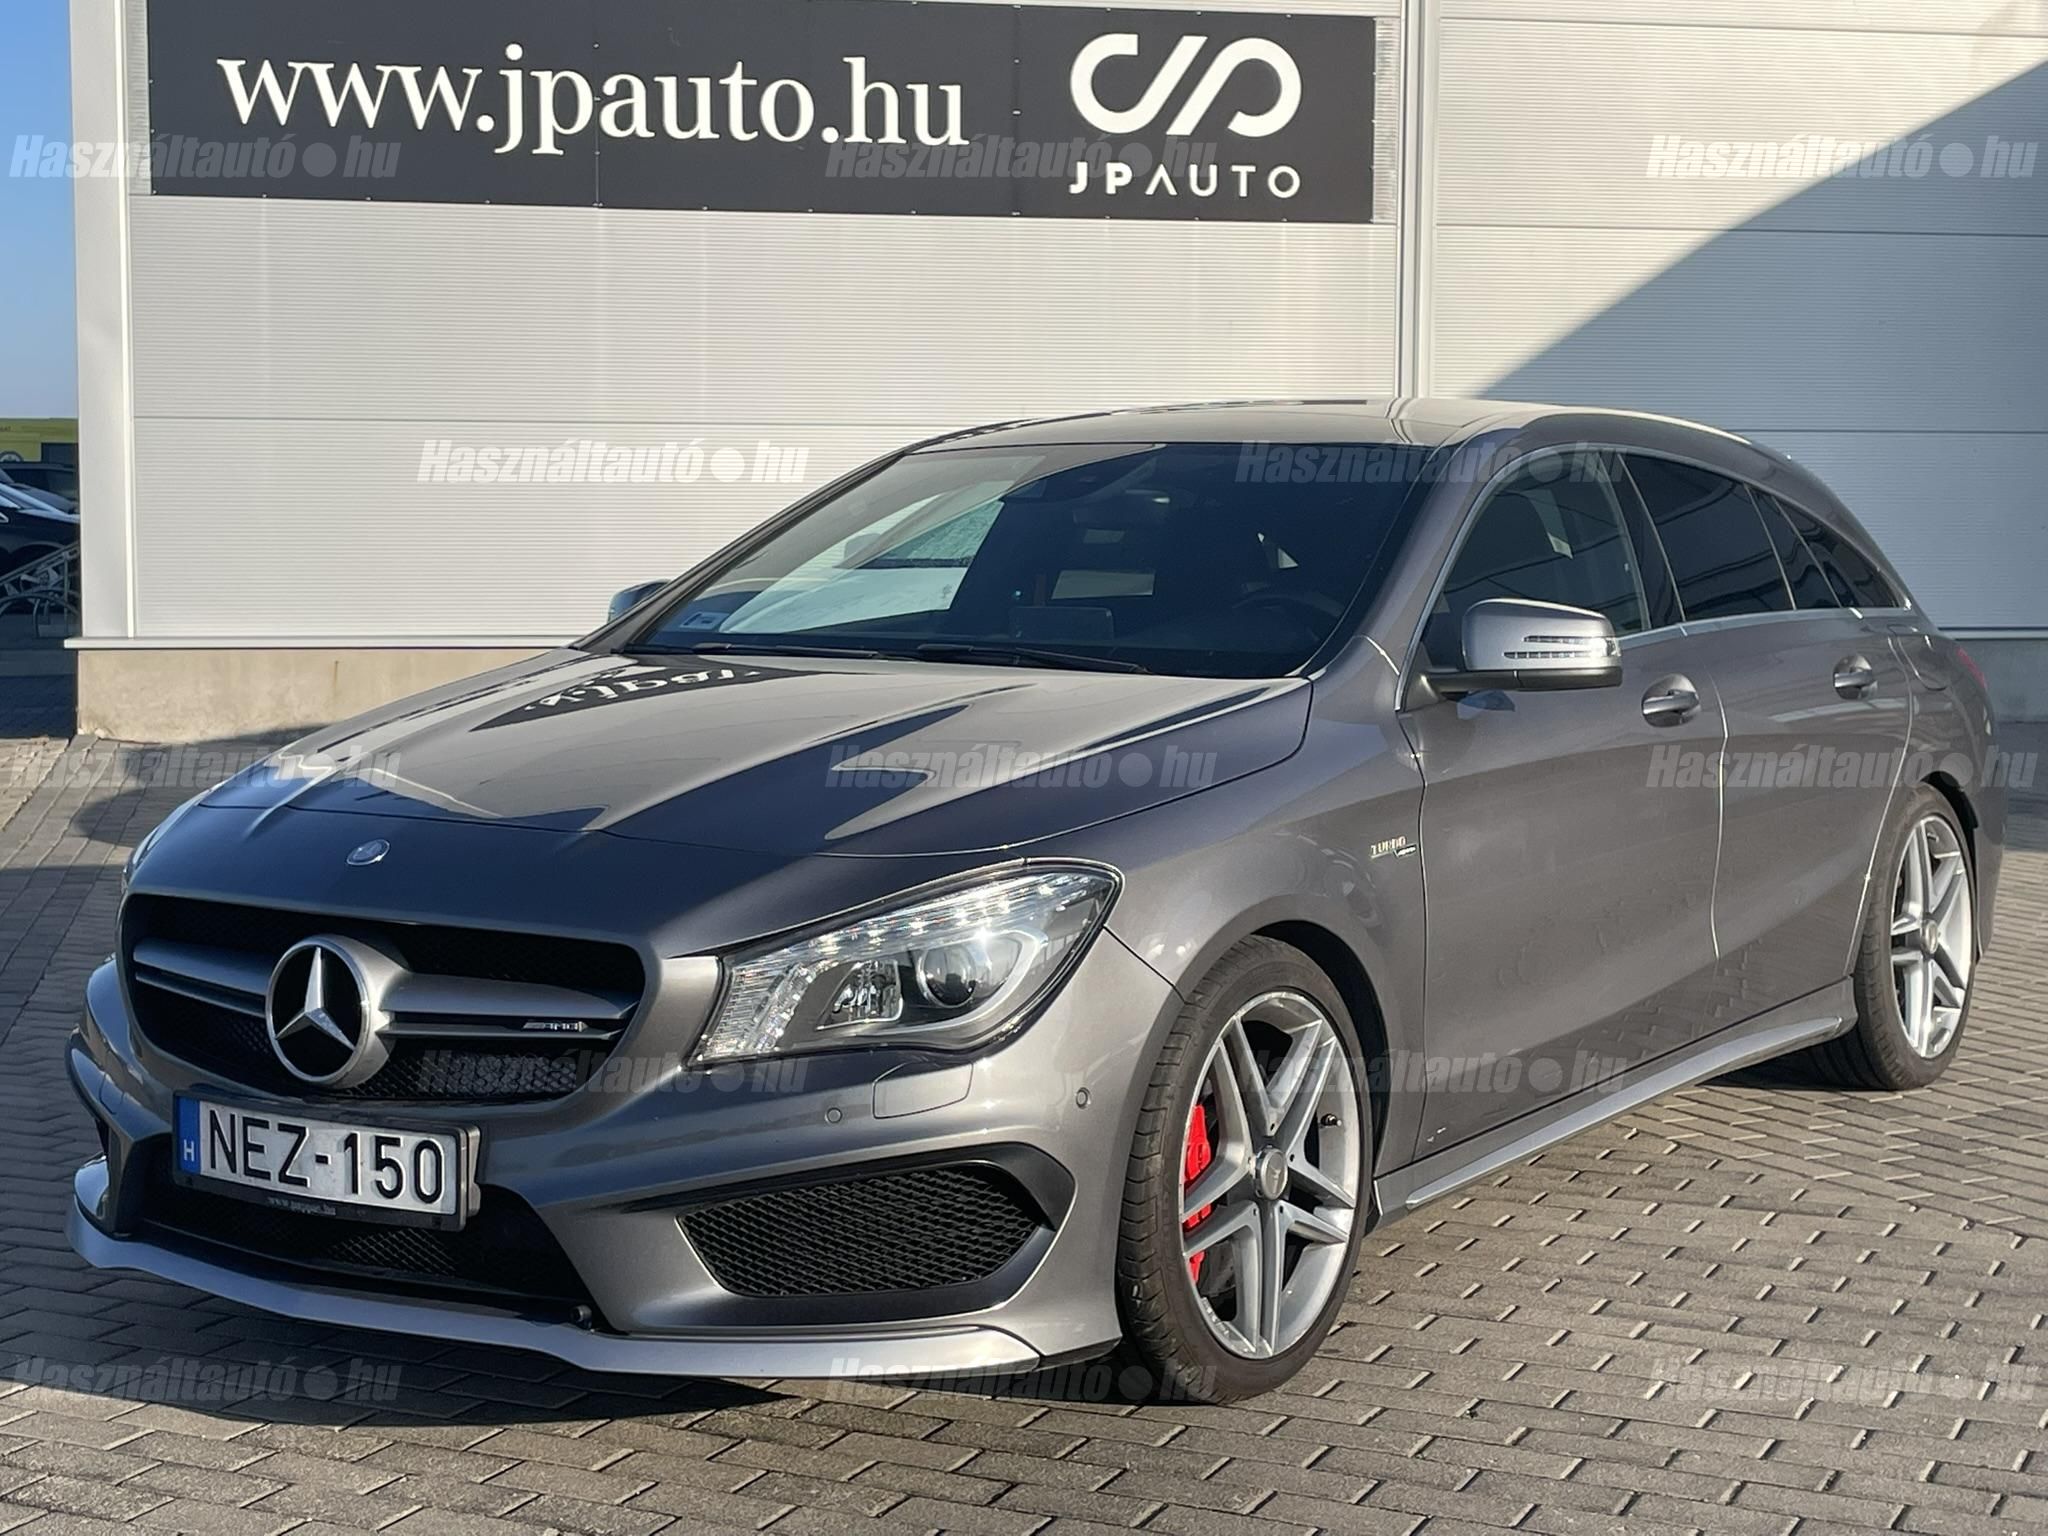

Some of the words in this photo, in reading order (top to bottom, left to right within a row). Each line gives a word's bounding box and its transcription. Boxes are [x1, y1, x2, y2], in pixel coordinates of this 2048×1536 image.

[216, 43, 971, 155] www.jpauto.hu
[183, 1139, 196, 1162] H
[208, 1109, 444, 1205] NEZ-150
